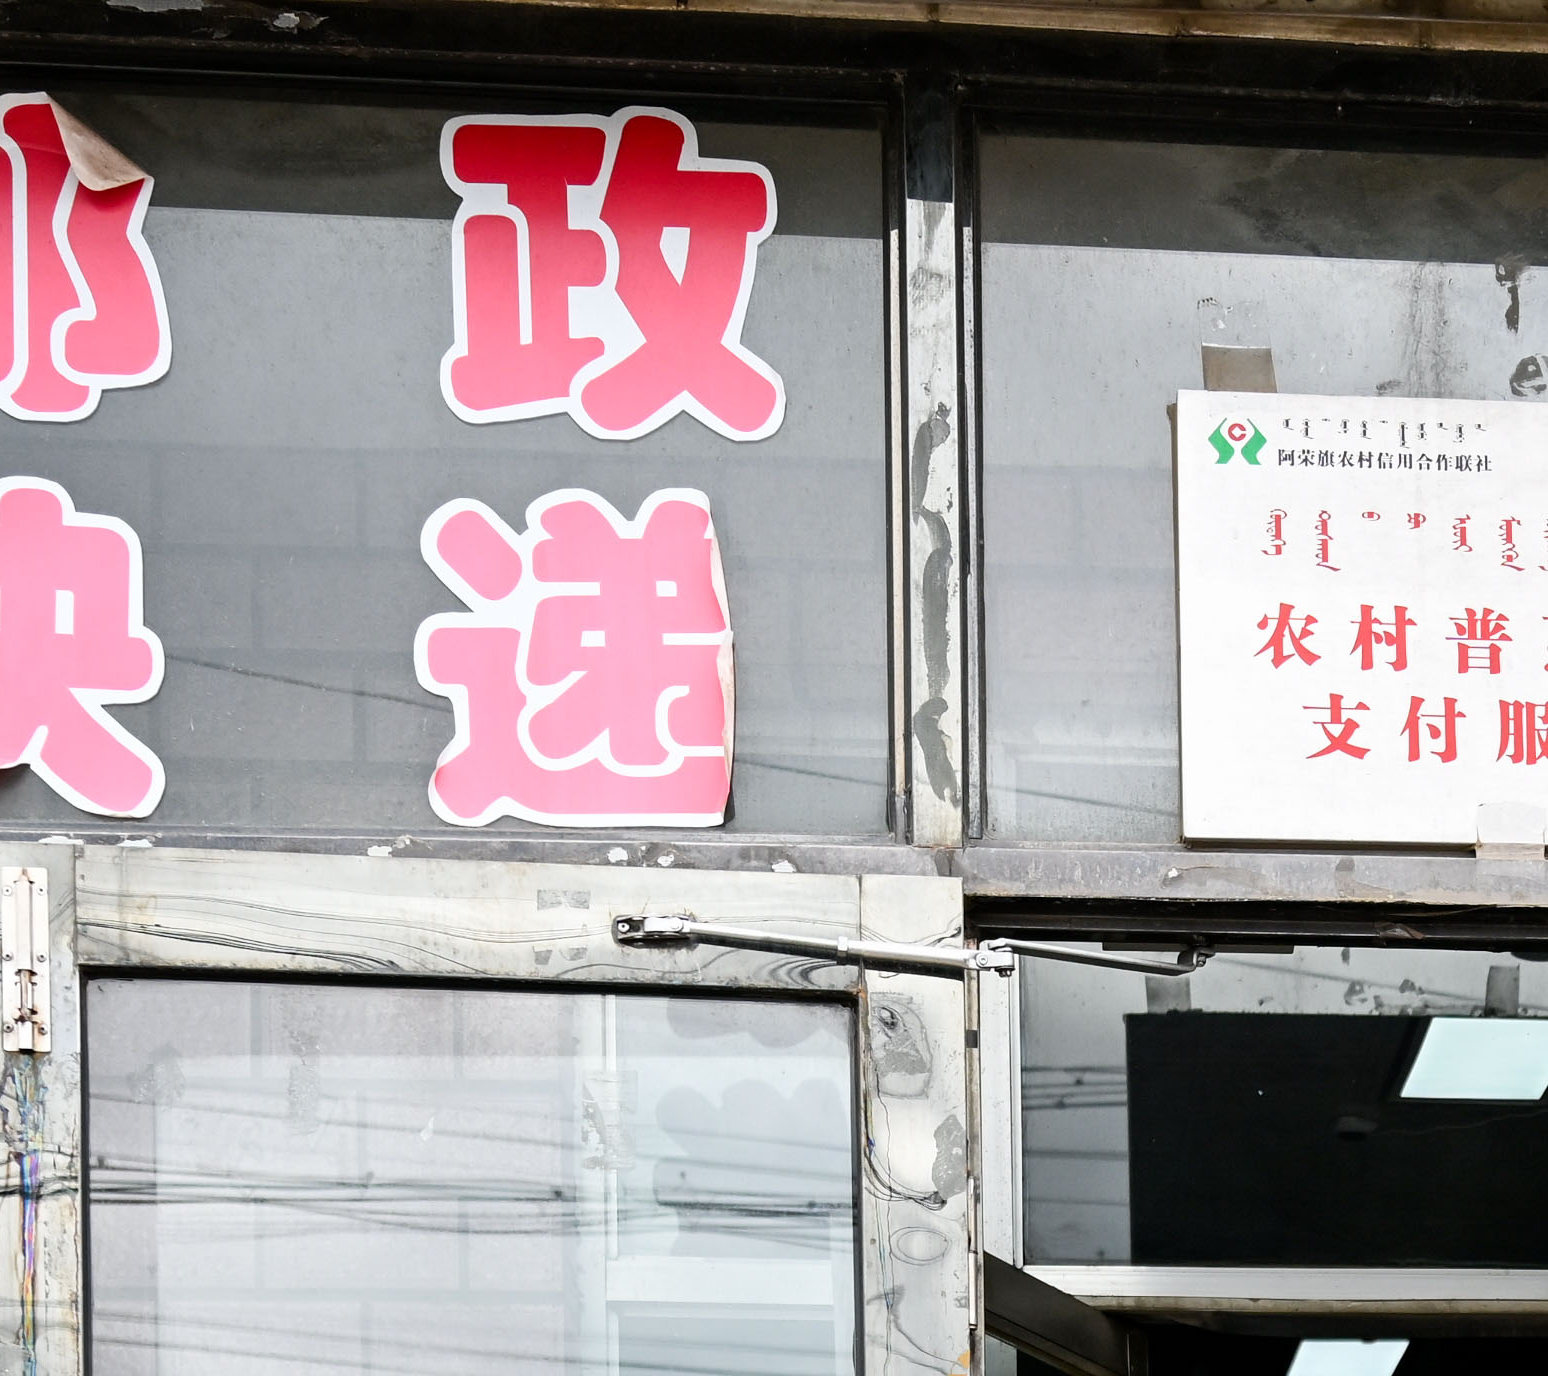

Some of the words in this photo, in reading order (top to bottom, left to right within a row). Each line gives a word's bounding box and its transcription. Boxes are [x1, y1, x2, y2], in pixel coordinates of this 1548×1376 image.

[1277, 449, 1493, 473] 阿荣旗农村信用合作联社
